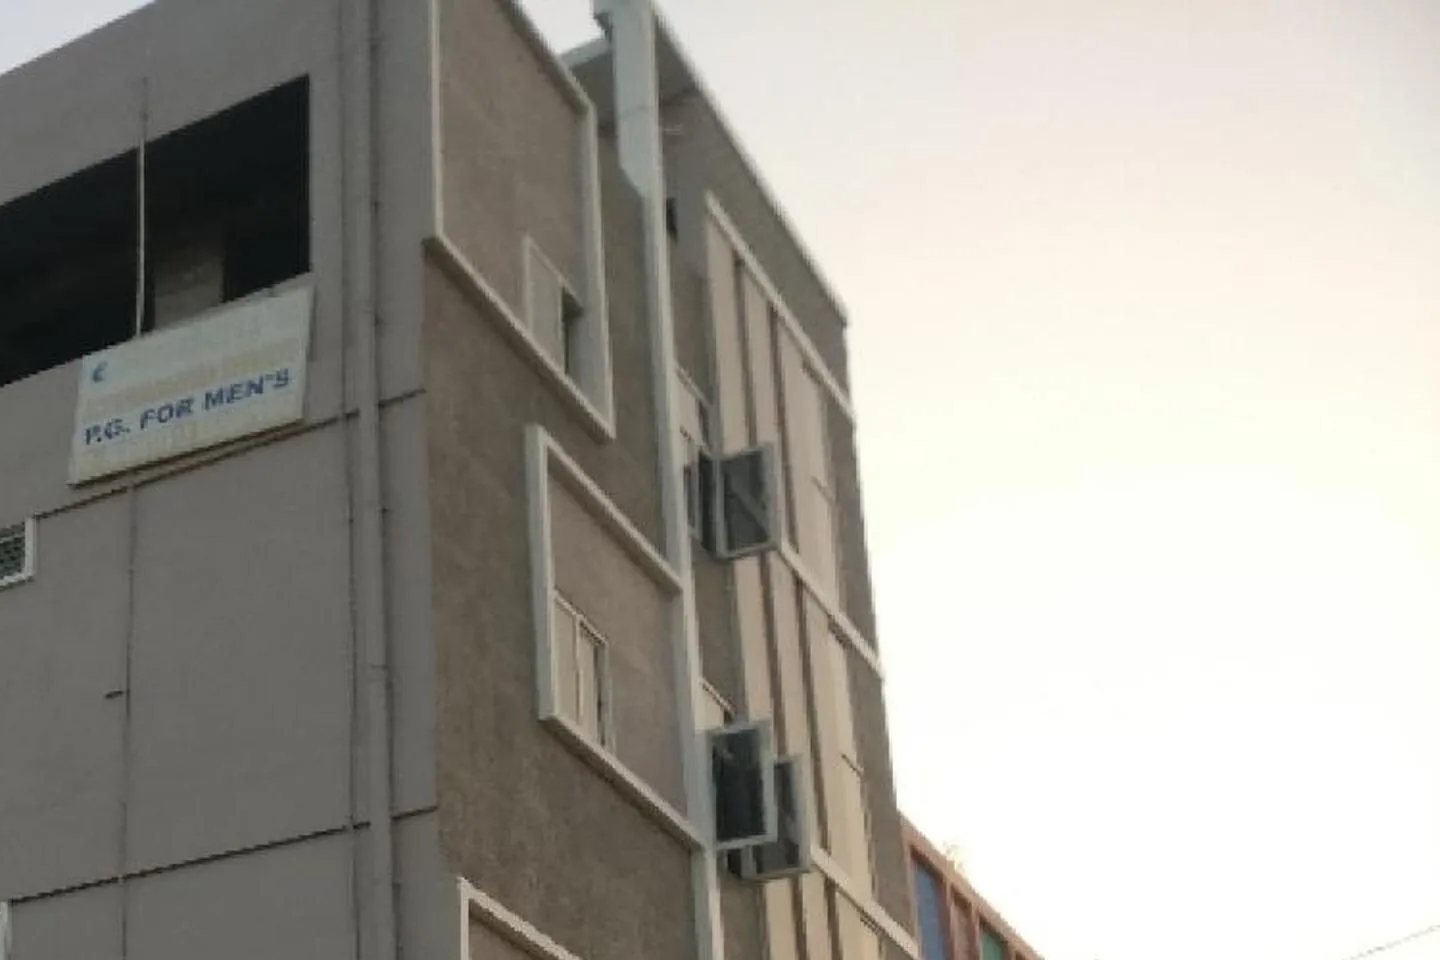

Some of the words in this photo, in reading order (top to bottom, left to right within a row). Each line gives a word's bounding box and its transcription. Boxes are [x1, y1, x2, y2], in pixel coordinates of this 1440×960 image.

[85, 418, 131, 445] P.G.
[140, 397, 195, 430] FOR
[204, 368, 290, 411] MEN'S
